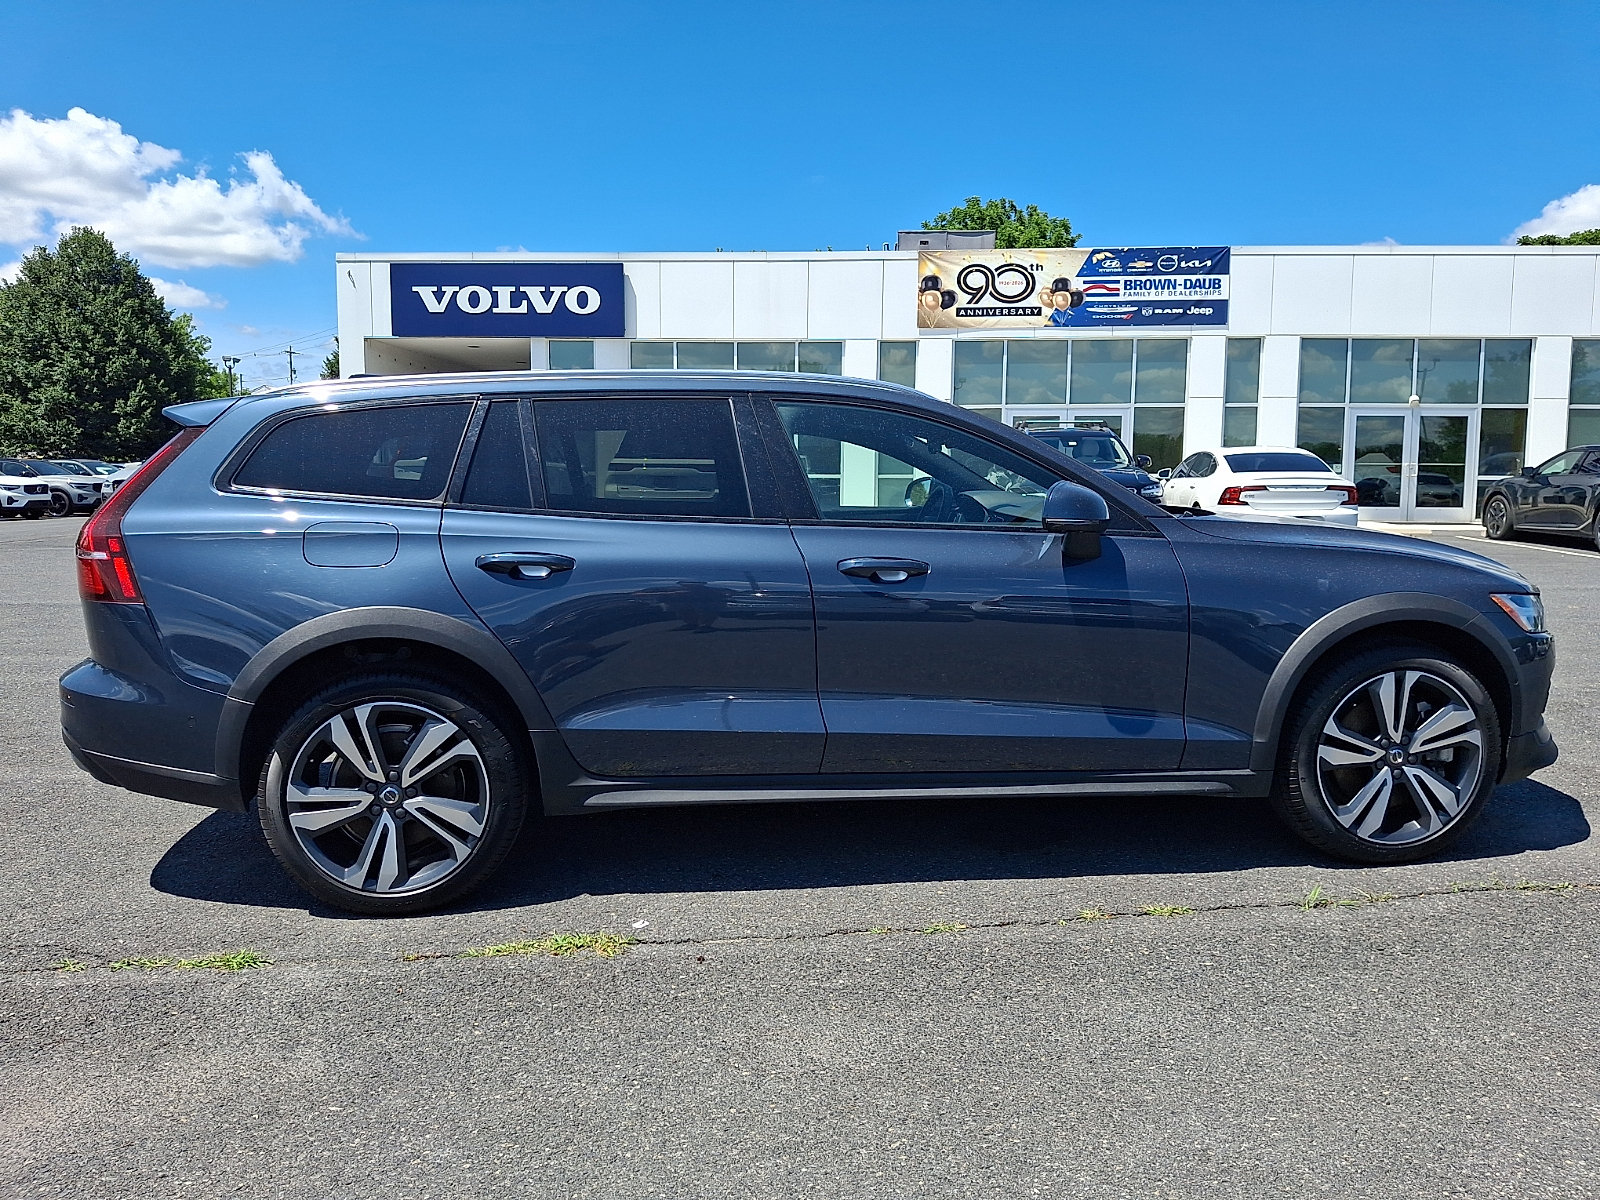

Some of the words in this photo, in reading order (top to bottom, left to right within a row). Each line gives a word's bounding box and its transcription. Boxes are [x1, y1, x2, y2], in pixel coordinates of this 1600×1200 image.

[1123, 278, 1222, 290] BROWN-DAUB
[1167, 289, 1222, 297] DEALERSHIPS
[411, 285, 602, 315] VOLVO
[959, 307, 1040, 316] ANNIVERSARY
[1186, 305, 1214, 316] Jeep
